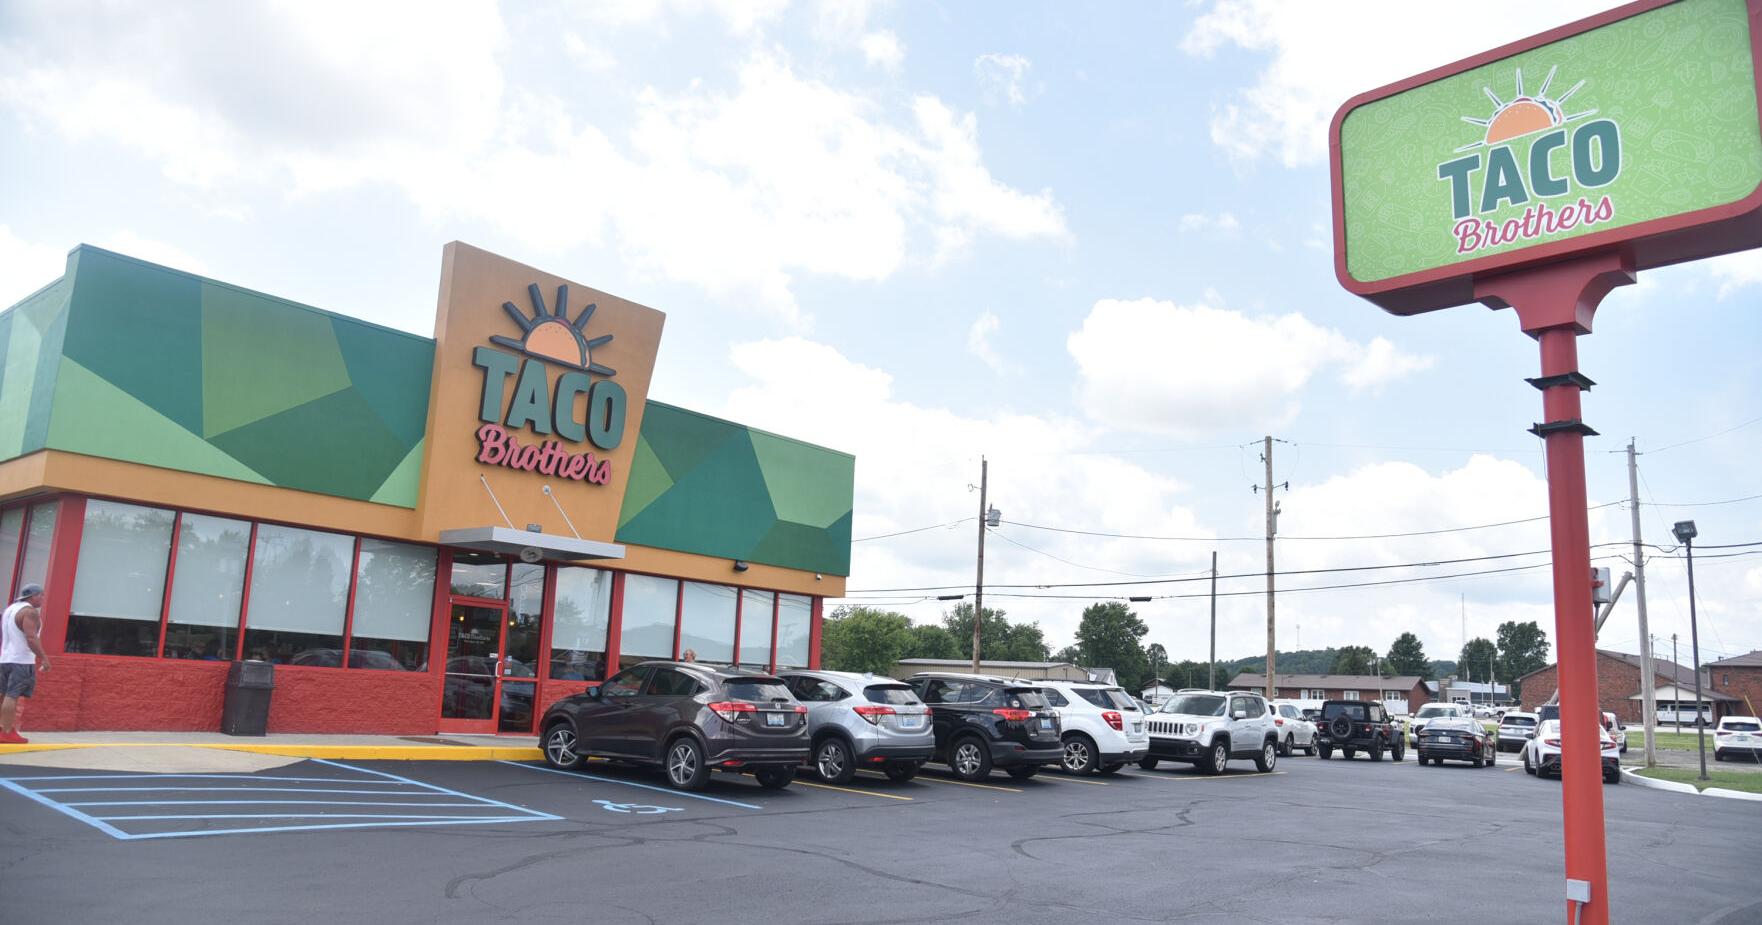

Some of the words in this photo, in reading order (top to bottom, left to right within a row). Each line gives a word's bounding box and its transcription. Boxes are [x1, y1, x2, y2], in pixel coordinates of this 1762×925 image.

[1439, 119, 1620, 219] TACO
[1453, 196, 1613, 254] Brothers
[473, 346, 627, 450] TACO
[475, 423, 611, 485] Brothers
